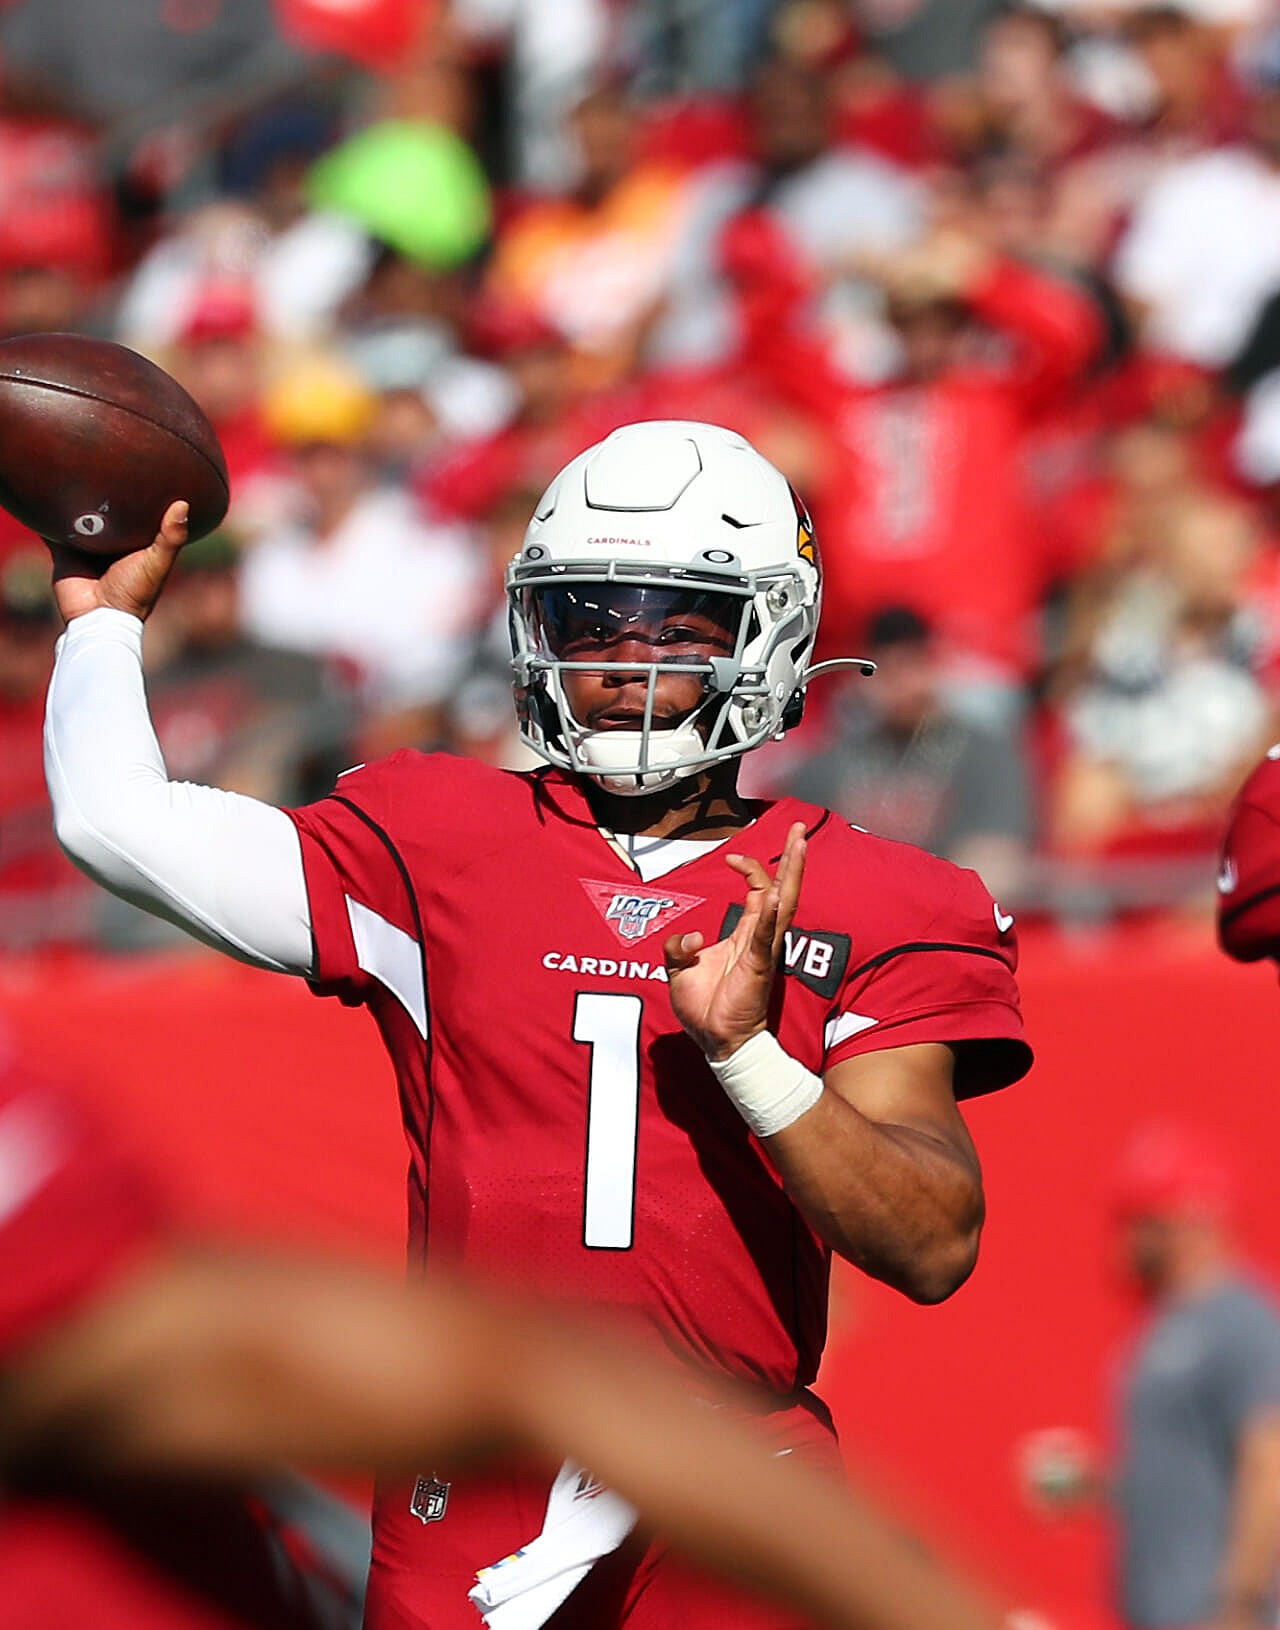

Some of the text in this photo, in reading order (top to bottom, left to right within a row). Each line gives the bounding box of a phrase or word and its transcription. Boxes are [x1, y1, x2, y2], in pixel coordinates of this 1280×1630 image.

[586, 537, 651, 546] CARDINALS
[543, 952, 669, 982] CARDINA
[784, 930, 834, 978] VB
[572, 991, 643, 1251] 1
